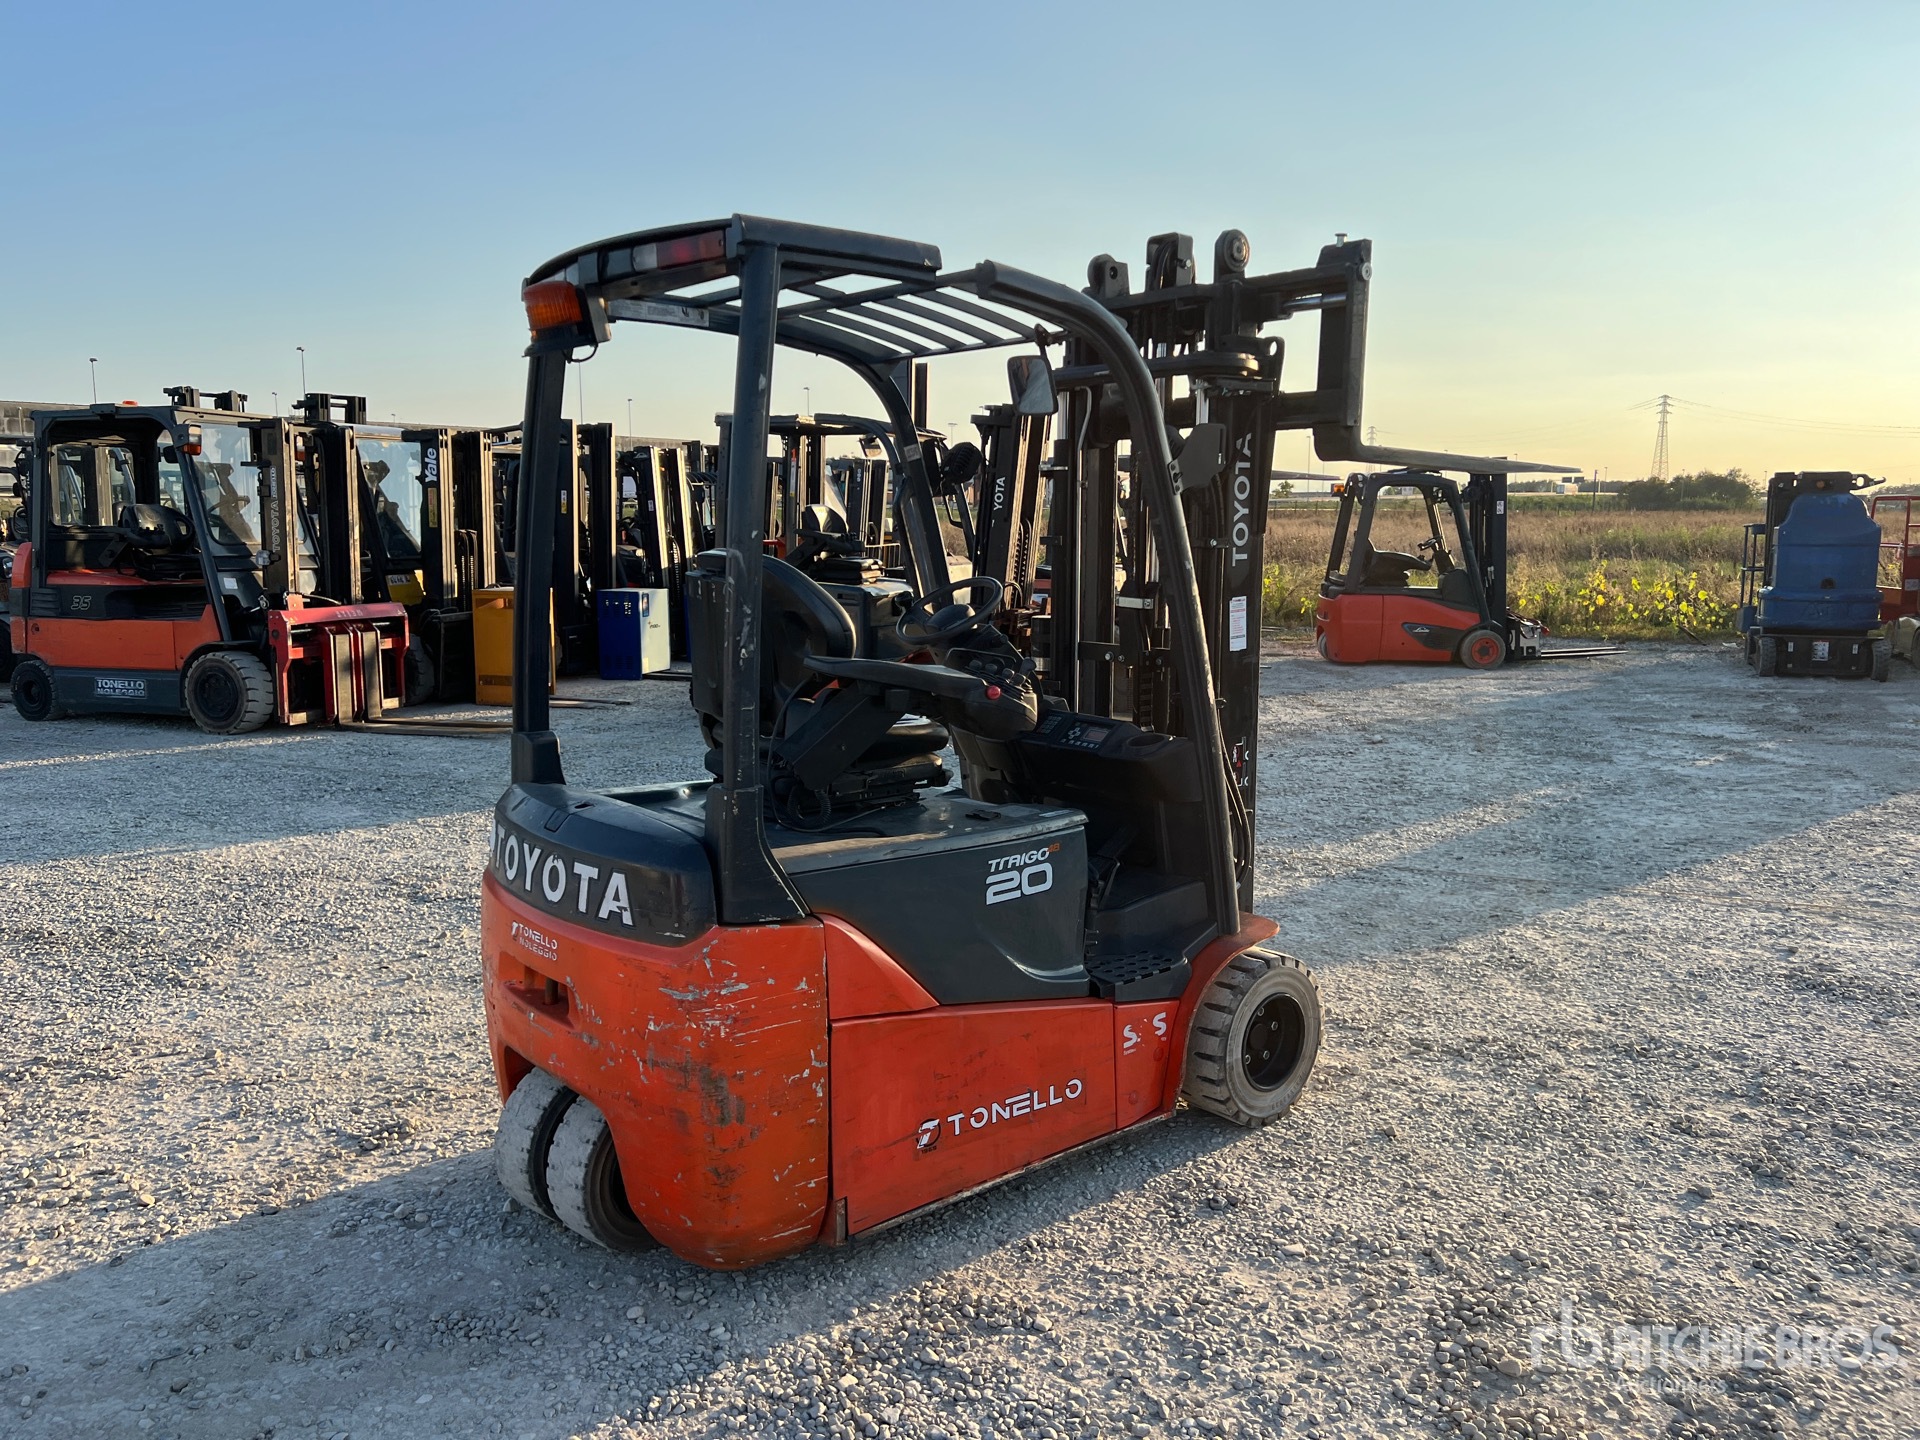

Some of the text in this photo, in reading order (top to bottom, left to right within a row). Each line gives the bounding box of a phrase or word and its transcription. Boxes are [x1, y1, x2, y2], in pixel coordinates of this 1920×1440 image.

[425, 448, 438, 483] Yale
[1232, 433, 1252, 567] TOYOTA
[271, 500, 281, 552] TOYOTA
[71, 595, 91, 610] 35
[97, 679, 145, 690] TONELLO
[496, 824, 634, 926] TOYOTA
[986, 862, 1053, 905] 20
[518, 923, 558, 950] TONELLO
[947, 1078, 1083, 1136] TONELLO
